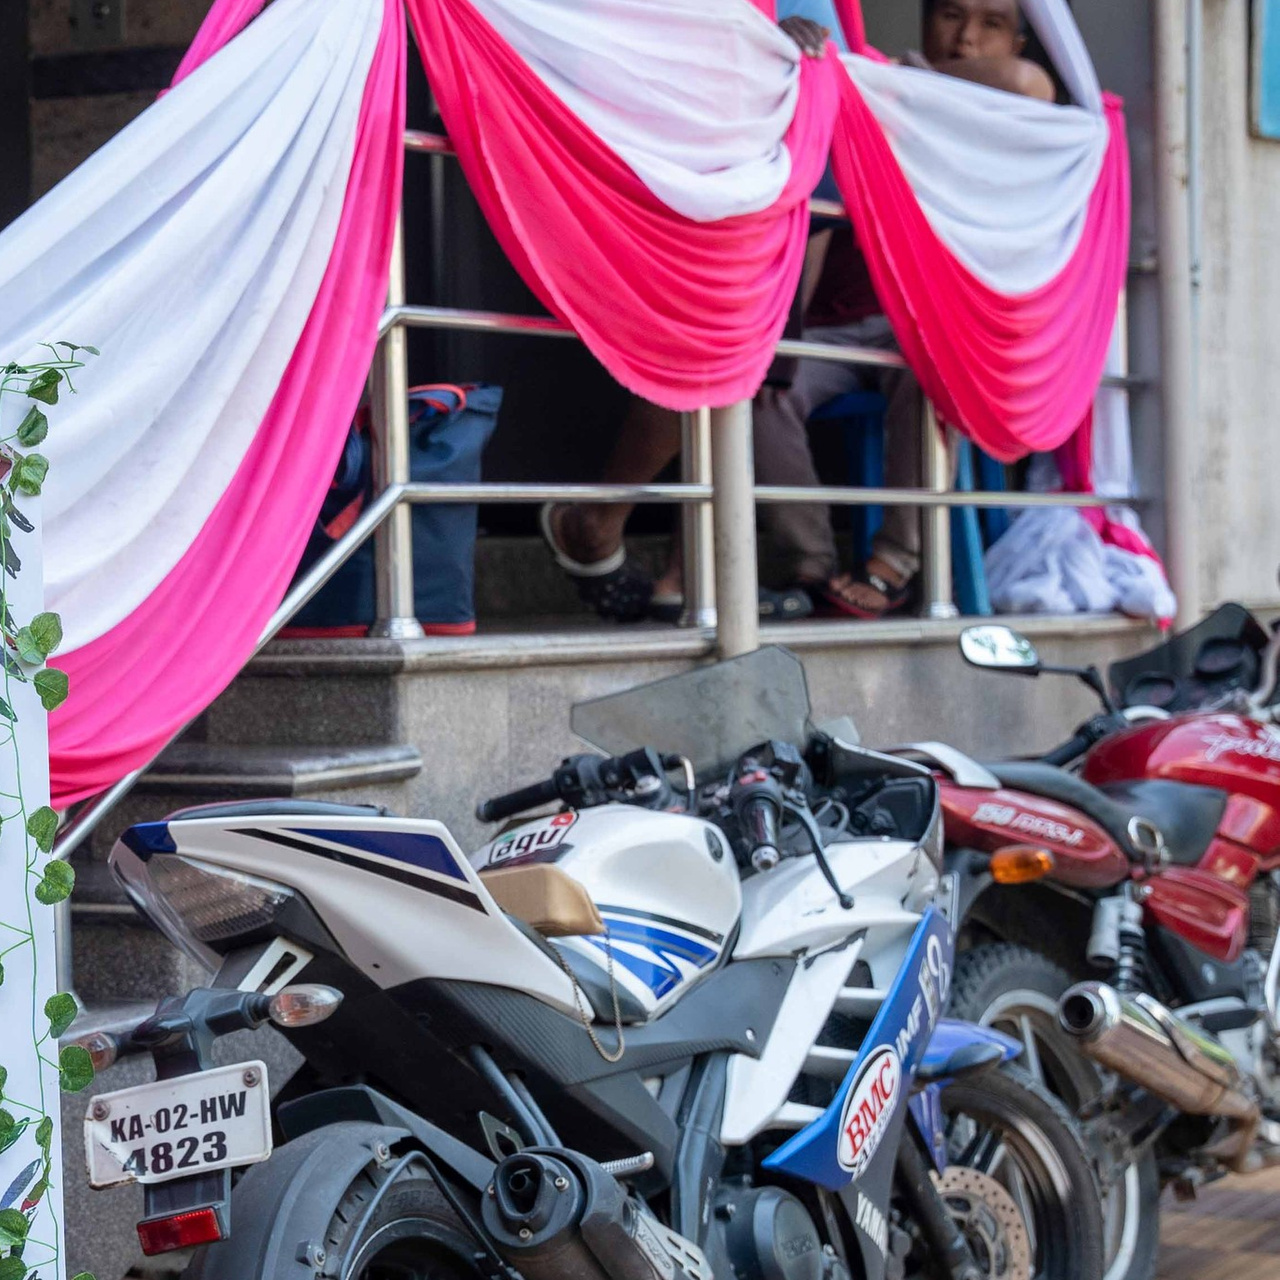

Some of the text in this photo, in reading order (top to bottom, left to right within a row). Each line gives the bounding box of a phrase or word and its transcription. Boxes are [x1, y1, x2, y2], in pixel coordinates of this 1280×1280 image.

[110, 1091, 247, 1144] KA-02-HW
[845, 1057, 895, 1160] BMC
[122, 1130, 228, 1177] 4823
